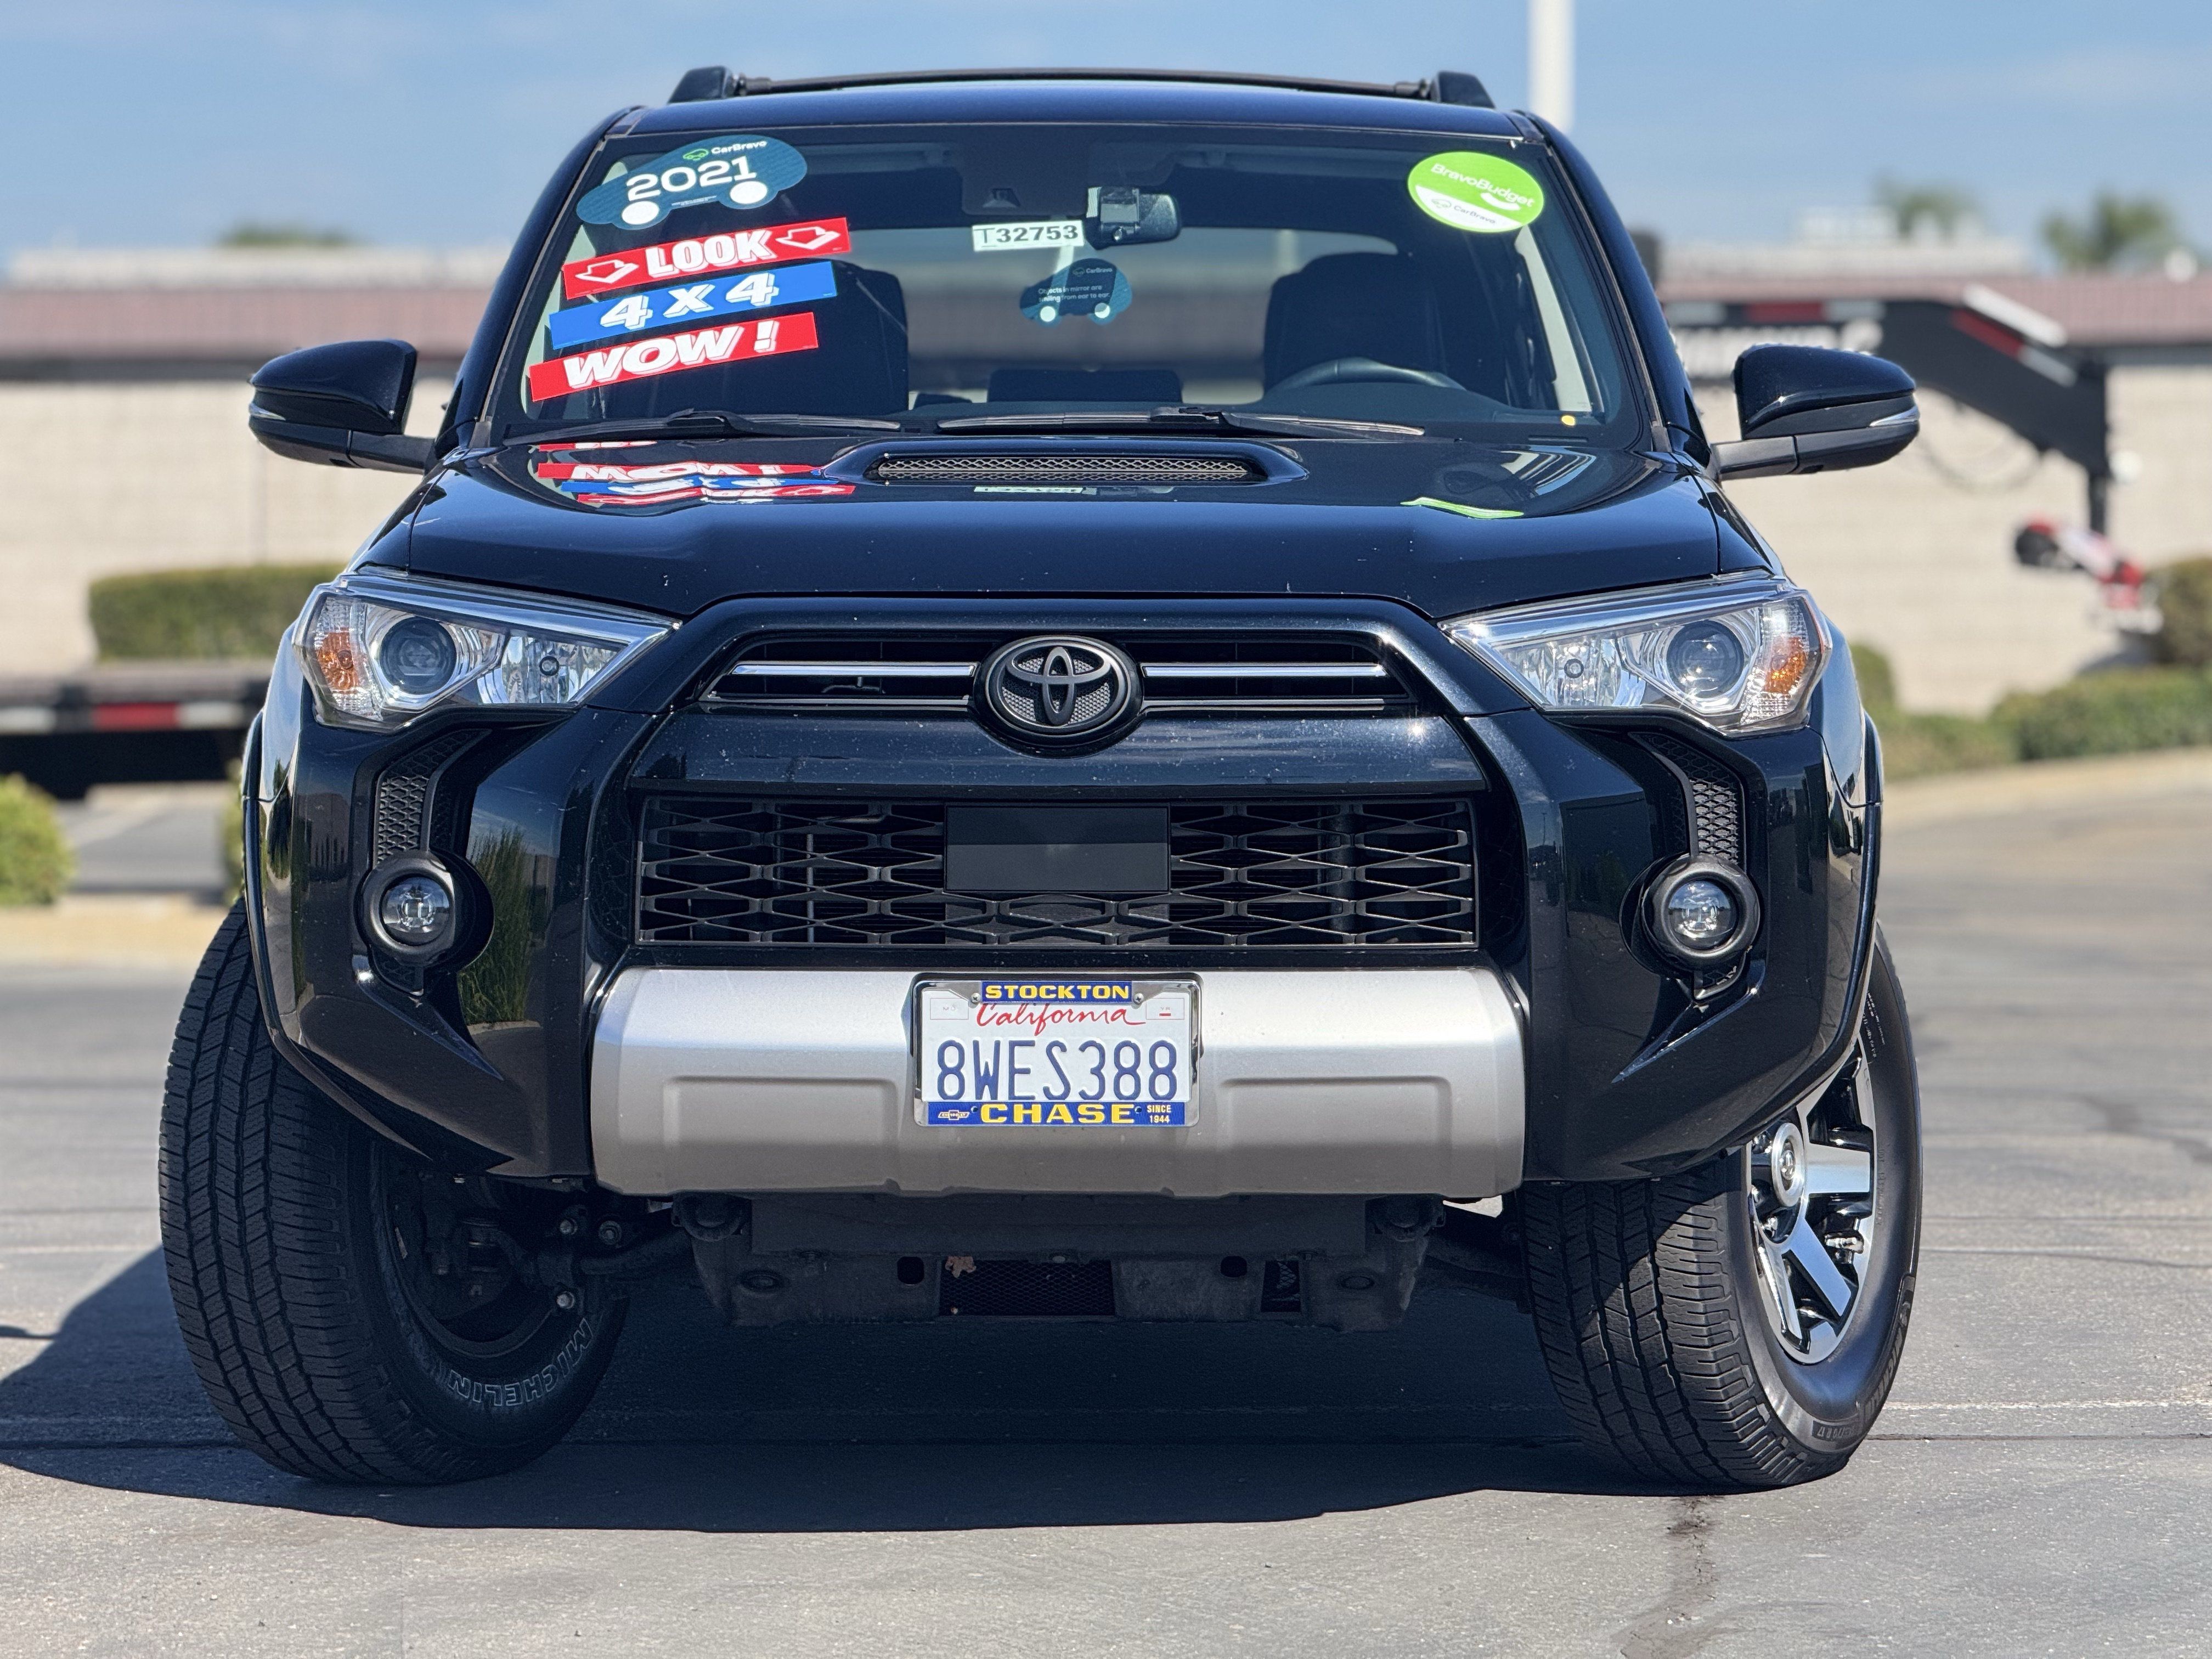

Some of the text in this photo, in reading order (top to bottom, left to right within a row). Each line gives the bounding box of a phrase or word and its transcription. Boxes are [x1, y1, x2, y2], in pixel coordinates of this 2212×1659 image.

[712, 140, 768, 155] CarBravo
[626, 156, 757, 201] 2021
[1431, 163, 1534, 207] BravoBudget
[1454, 205, 1496, 224] CarBravo
[646, 230, 777, 277] LOOK
[601, 295, 653, 330] 4
[725, 272, 779, 307] 4
[1038, 287, 1062, 295] Objects
[563, 324, 744, 389] WOW
[985, 984, 1130, 1000] STOCKTON
[976, 1002, 1146, 1036] California
[937, 1040, 1177, 1102] 8WES388
[980, 1103, 1135, 1124] CHASE
[1147, 1104, 1172, 1113] SINCE
[448, 1317, 594, 1407] MICHELIN
